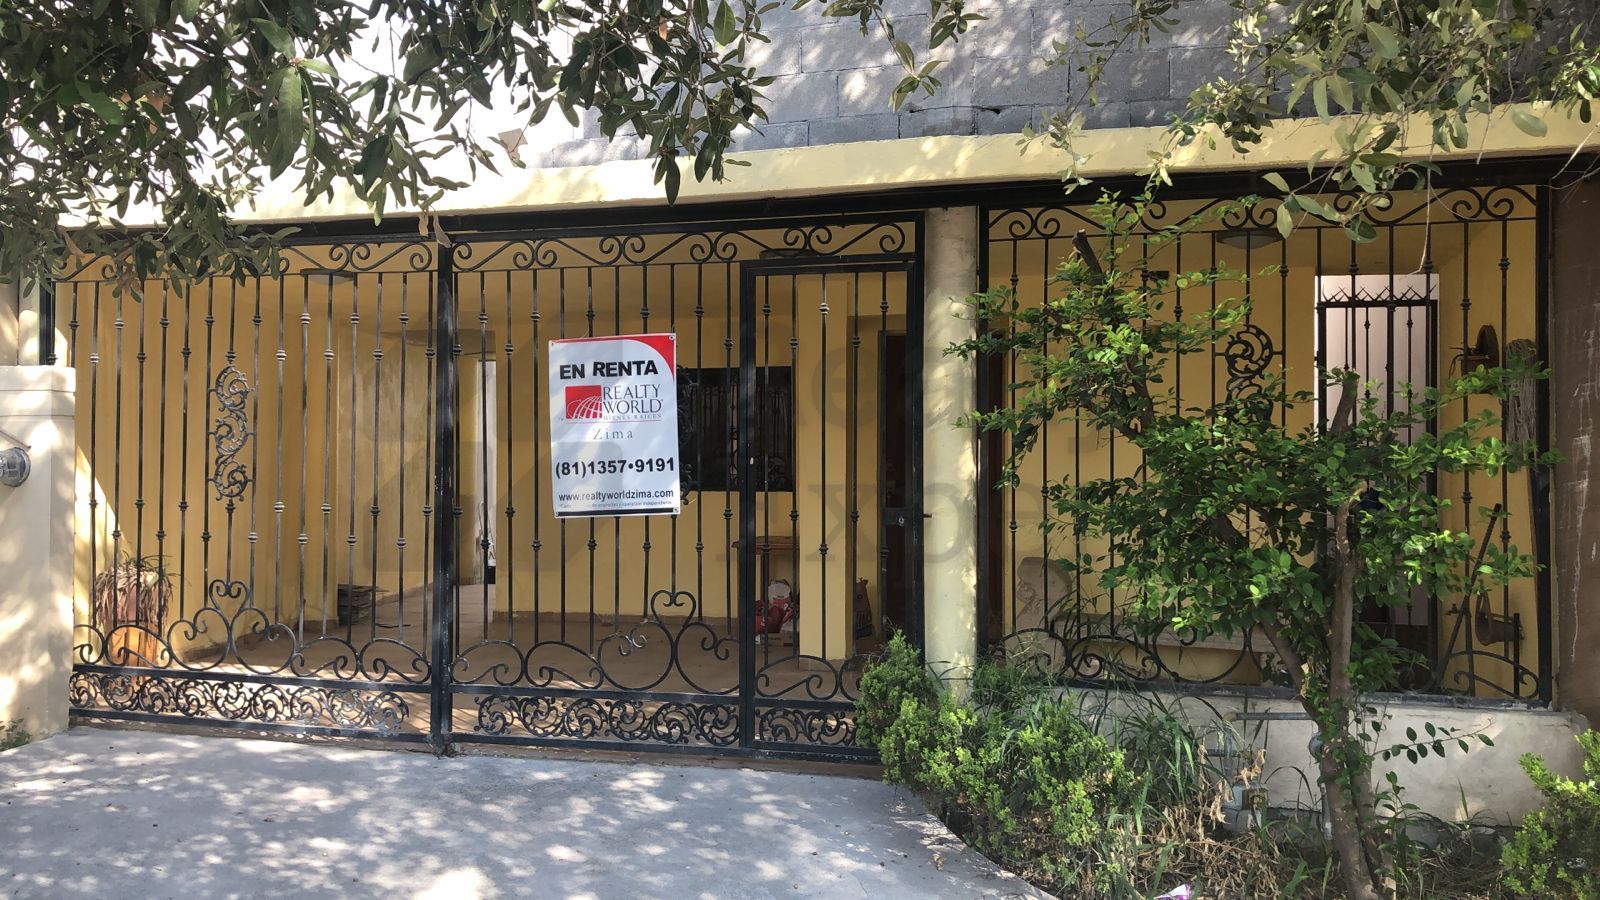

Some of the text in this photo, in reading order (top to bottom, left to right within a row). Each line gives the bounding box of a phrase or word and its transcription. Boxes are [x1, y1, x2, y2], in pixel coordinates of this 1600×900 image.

[560, 360, 659, 380] EN RENTA
[603, 384, 661, 400] REALTY
[603, 399, 662, 414] WORLD
[592, 427, 633, 440] Zima
[558, 489, 674, 502] www.realtyworldzima.com
